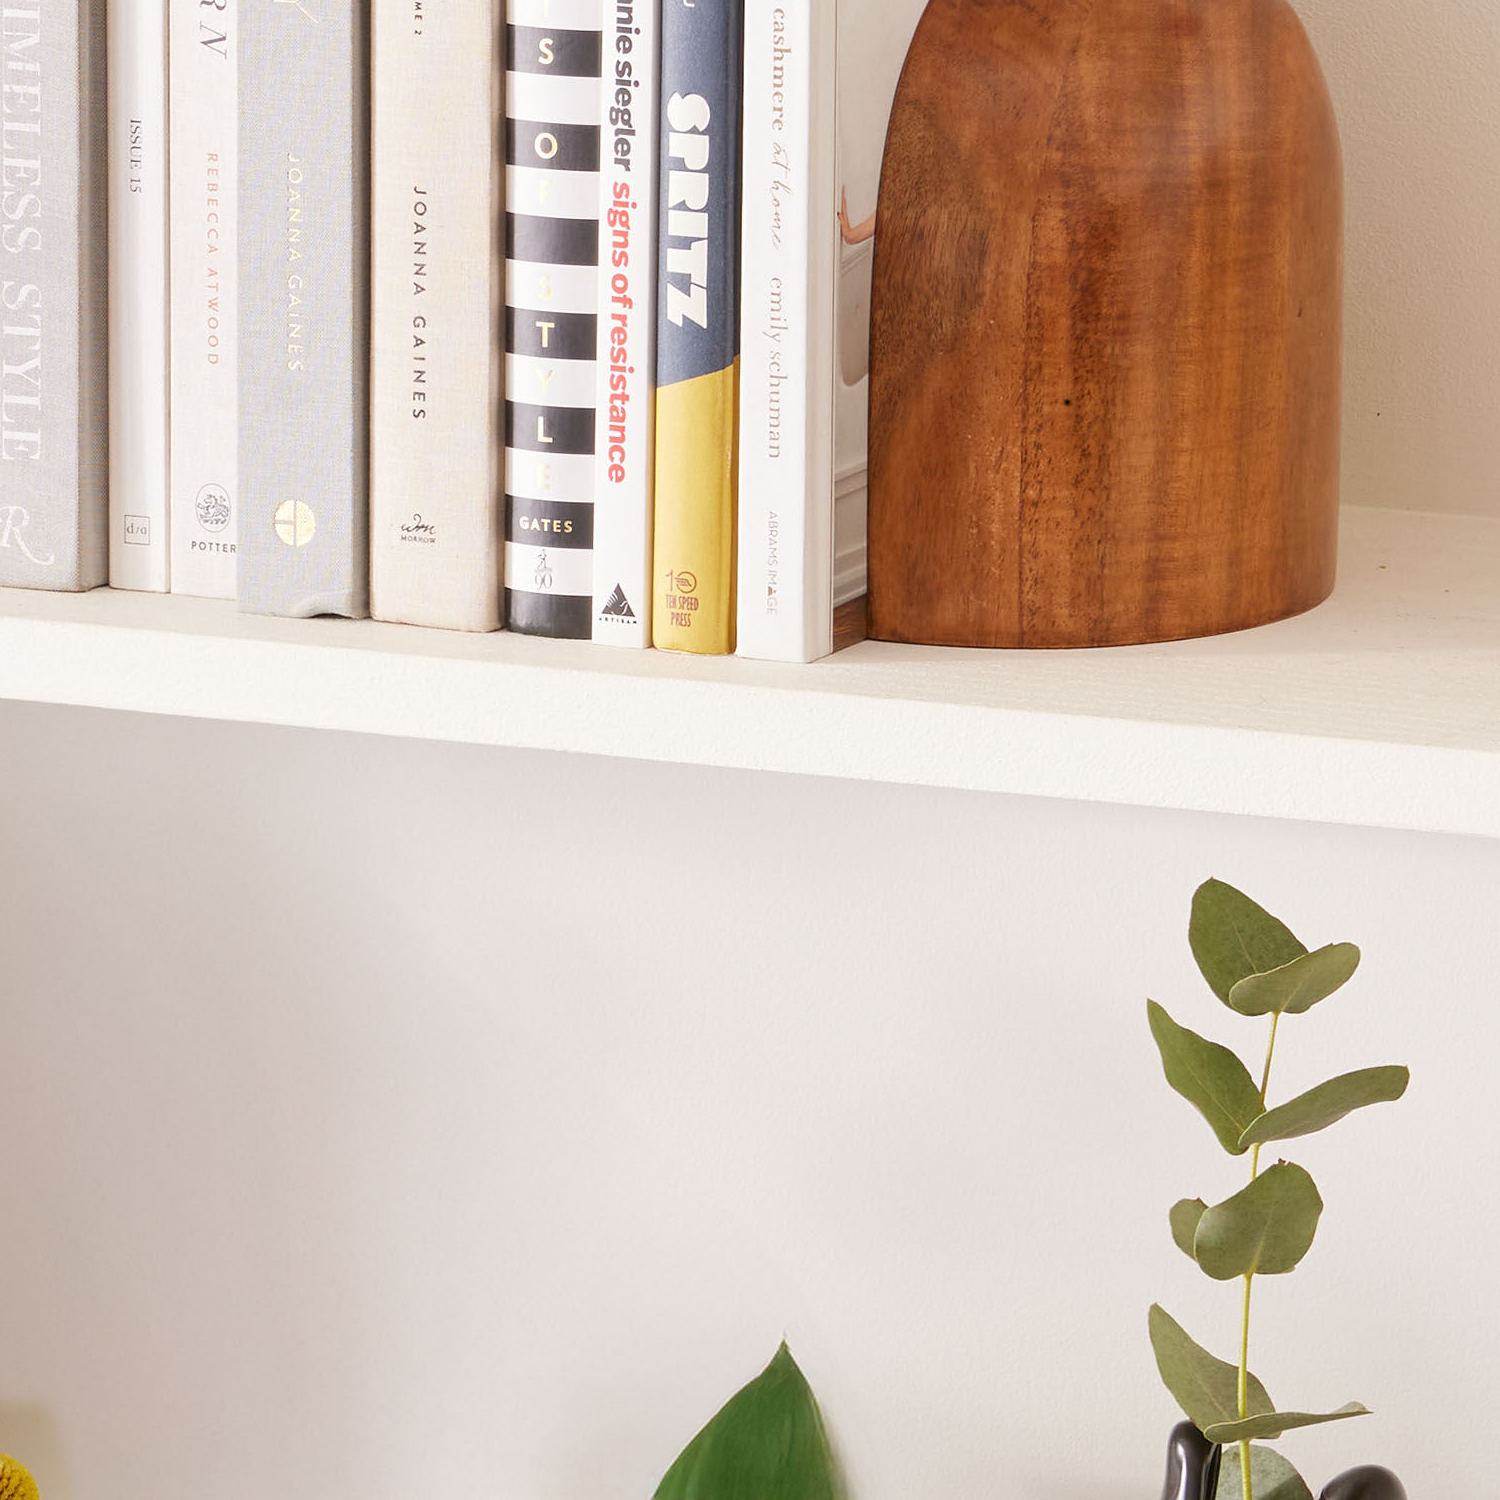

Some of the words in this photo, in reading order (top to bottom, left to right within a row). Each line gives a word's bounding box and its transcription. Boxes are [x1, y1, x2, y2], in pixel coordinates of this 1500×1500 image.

[772, 8, 792, 132] cashmere
[129, 118, 141, 170] ISSUE
[609, 58, 640, 172] siegler
[129, 176, 141, 193] 15
[771, 141, 792, 175] at
[206, 152, 219, 255] REBECCA
[286, 152, 304, 263] JOANNA
[413, 186, 428, 296] JOANNA
[607, 181, 638, 267] signs
[666, 92, 711, 329] SPRITZ
[769, 180, 795, 251] home
[206, 267, 219, 365] ATWOOD
[285, 274, 304, 372] GAINES
[612, 273, 634, 311] of
[762, 277, 789, 343] emily
[0, 280, 43, 461] STYLE
[412, 315, 427, 419] GAINES
[608, 312, 635, 484] resistance
[768, 351, 789, 459] schuman
[191, 540, 237, 553] POTTER
[518, 516, 574, 534] GATES
[767, 511, 779, 566] ABRAMS
[598, 616, 639, 625] ARTISAN
[665, 594, 677, 609] TEN
[678, 595, 700, 612] SPEED
[670, 611, 693, 628] PRESS
[766, 570, 778, 617] IMAGE
